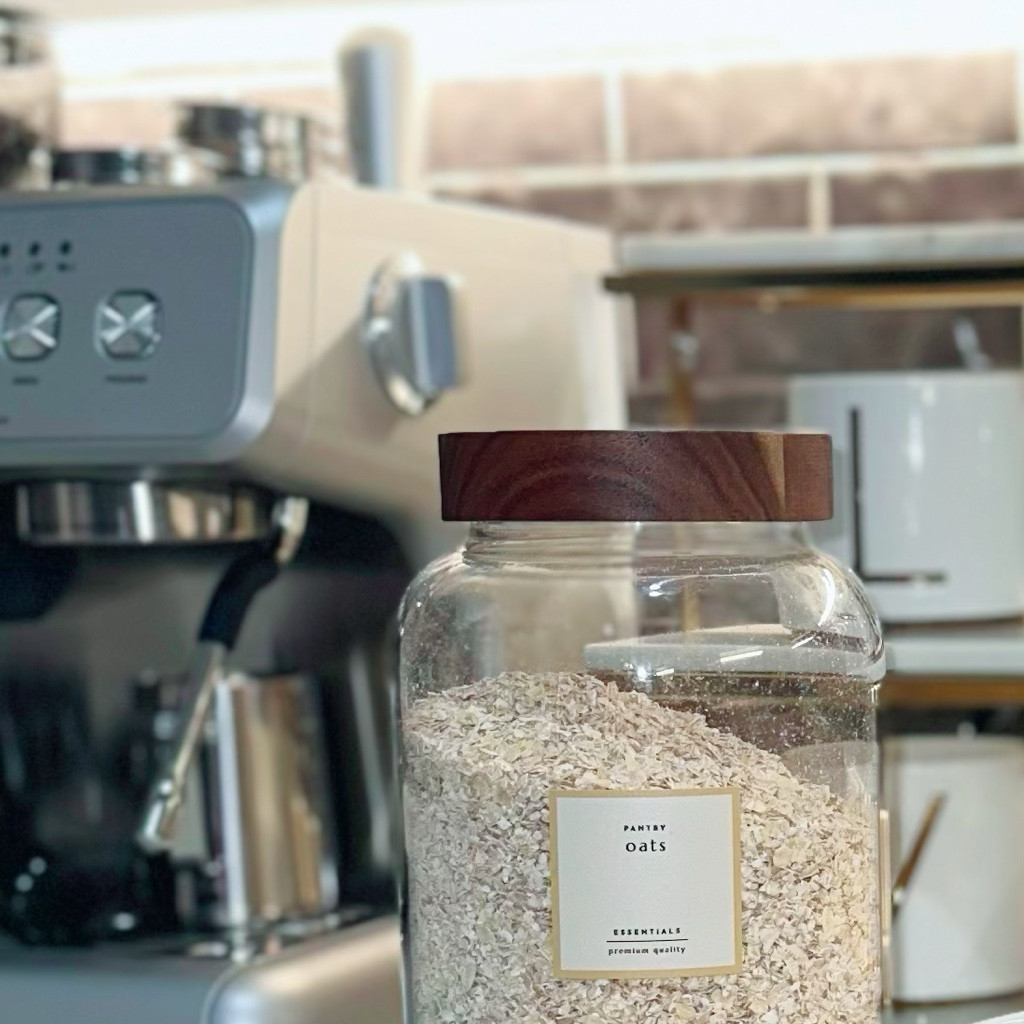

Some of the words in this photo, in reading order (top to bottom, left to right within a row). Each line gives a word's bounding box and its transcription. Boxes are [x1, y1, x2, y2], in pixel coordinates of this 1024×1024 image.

[849, 407, 947, 584] L
[623, 824, 667, 832] PANTRY
[625, 839, 667, 852] oats
[613, 927, 682, 936] ESSENTIALS
[608, 947, 649, 956] premium
[653, 946, 686, 956] quality
